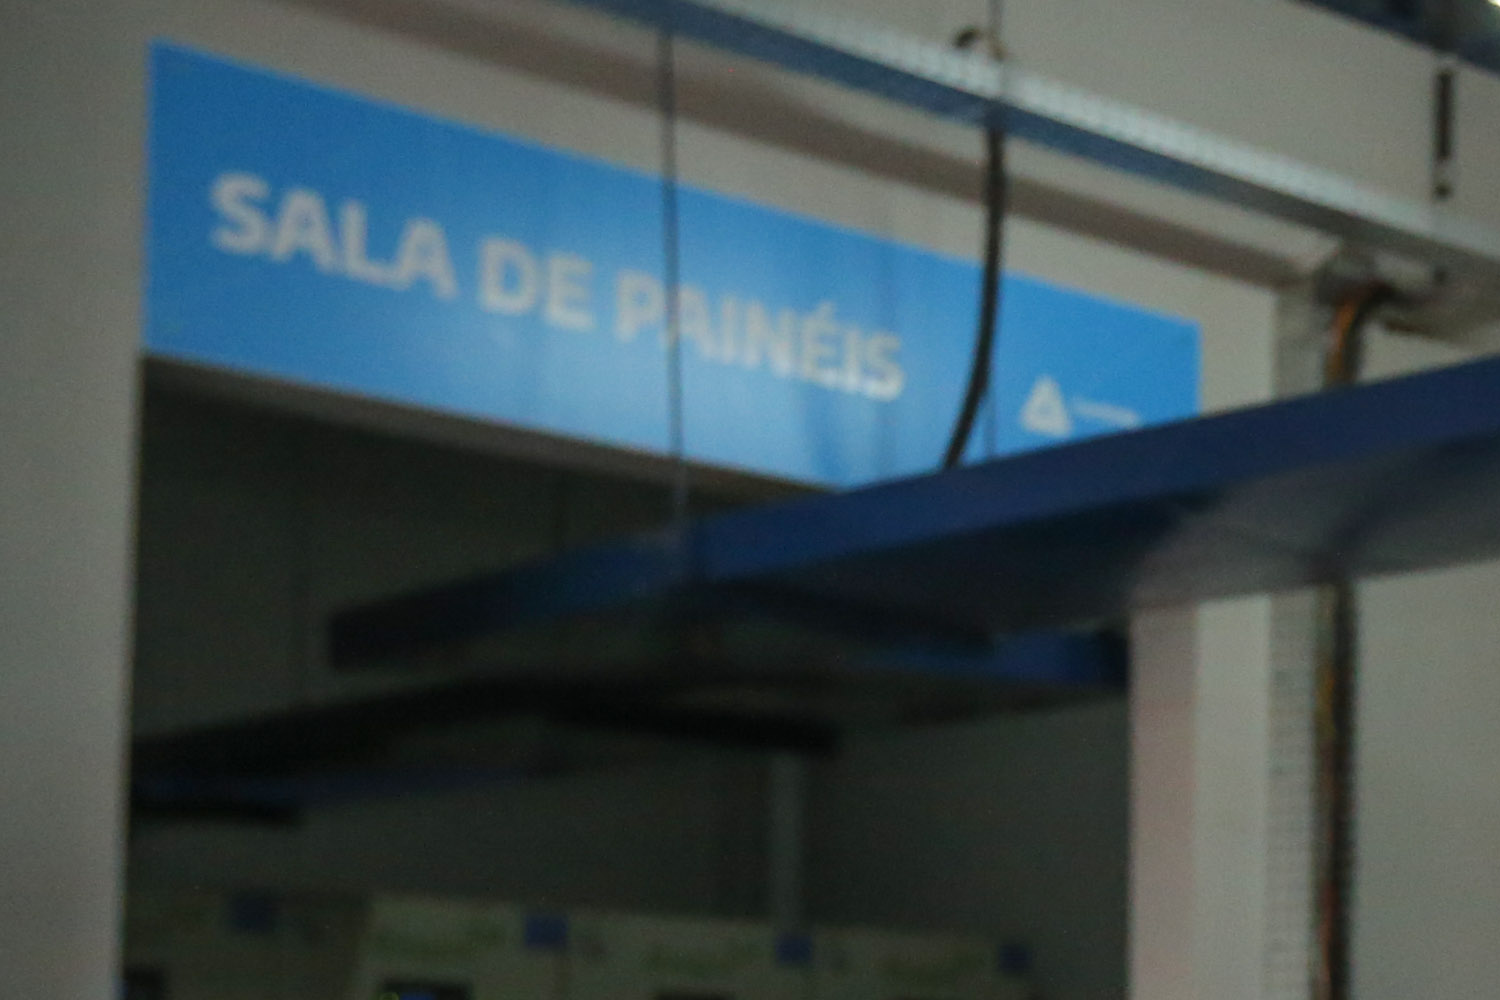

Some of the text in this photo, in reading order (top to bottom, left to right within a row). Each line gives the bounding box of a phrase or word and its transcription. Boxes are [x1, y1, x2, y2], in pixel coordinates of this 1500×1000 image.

[210, 171, 905, 400] SALA DE PAINÉIS
